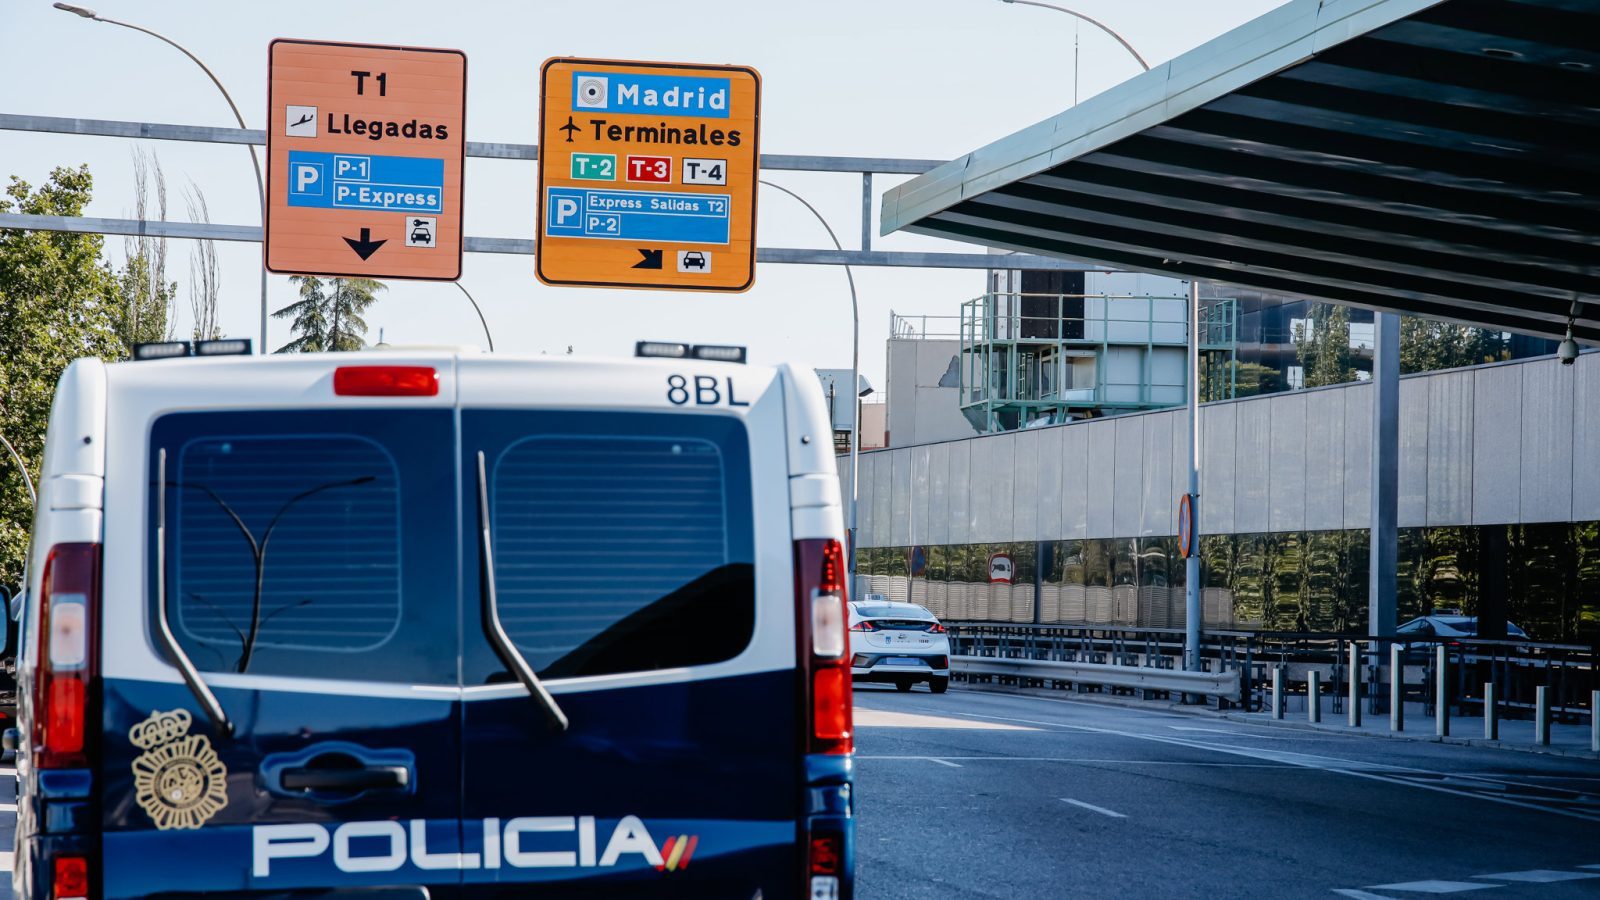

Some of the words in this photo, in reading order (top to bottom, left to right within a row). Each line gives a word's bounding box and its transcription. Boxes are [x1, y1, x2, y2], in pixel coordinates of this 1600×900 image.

[351, 70, 387, 97] T1
[617, 83, 726, 110] Madrid
[327, 112, 449, 141] Llegadas
[590, 119, 742, 147] Terminales
[297, 165, 319, 192] P
[338, 160, 367, 177] P-1
[575, 157, 612, 177] T-2
[631, 160, 667, 179] T-3
[687, 162, 722, 181] T-4
[337, 186, 437, 207] P-Express
[589, 195, 642, 211] Express
[650, 198, 700, 212] Salidas
[707, 200, 724, 213] T2
[556, 198, 578, 225] P
[589, 216, 617, 232] P-2
[667, 374, 750, 407] 8BL
[253, 814, 665, 878] POLICIA
